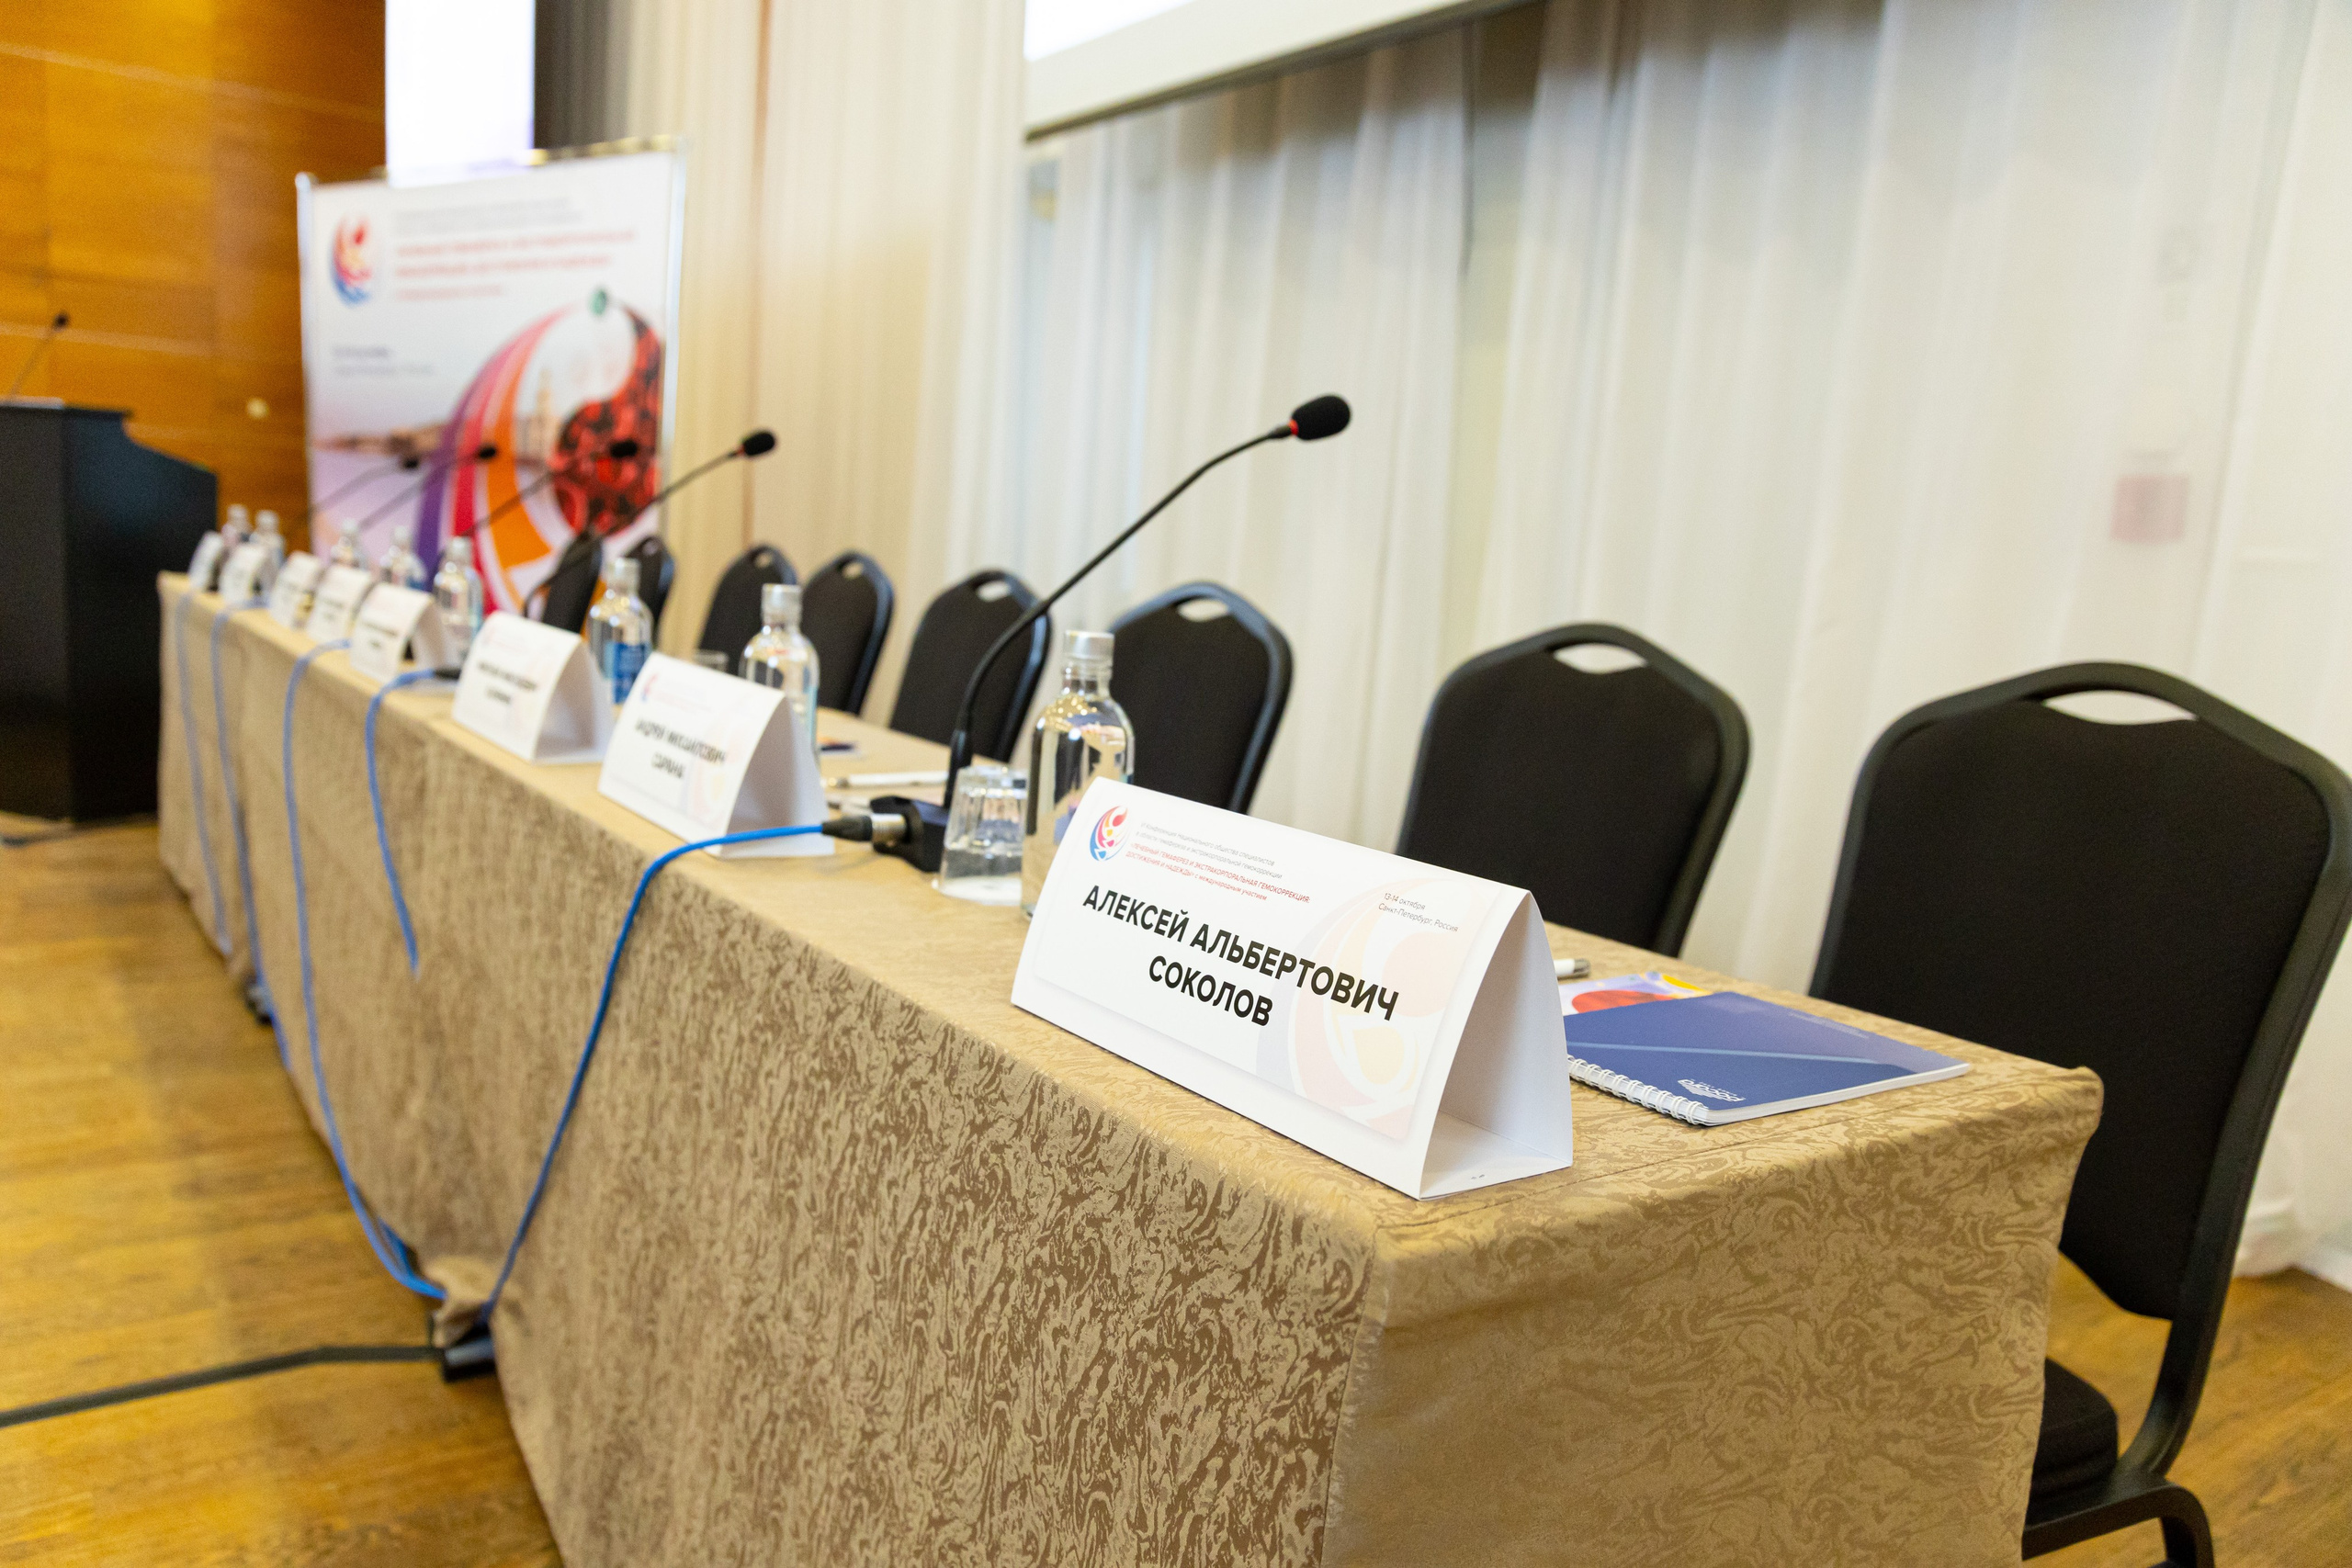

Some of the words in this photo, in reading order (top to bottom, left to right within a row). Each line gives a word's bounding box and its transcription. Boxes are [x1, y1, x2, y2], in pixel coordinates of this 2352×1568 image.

[1191, 848, 1241, 866] экстракорпоральной
[1241, 863, 1283, 879] гемокоррекции
[1214, 844, 1238, 856] общества
[1238, 852, 1275, 866] специалистов
[1125, 851, 1160, 865] ДОСТИЖЕНИЯ
[1199, 874, 1241, 892] международным
[1241, 889, 1267, 901] участием
[1159, 852, 1190, 864] ГЕМАФЕРЕЗ
[1194, 862, 1258, 887] ЭКСТРАКОРПОРАЛЬНАЯ
[1258, 882, 1310, 903] ГЕМОКОРРЕКЦИЯ:
[1378, 903, 1432, 926] Санкт-Петербург,
[1434, 919, 1458, 932] Россия
[1384, 893, 1399, 902] 13-14
[1398, 898, 1426, 910] октября
[1082, 885, 1191, 942] АЛЕКСЕЙ
[1190, 923, 1399, 1021] АЛЬБЕРТОВИЧ
[1148, 955, 1273, 1027] СОКОЛОВ
